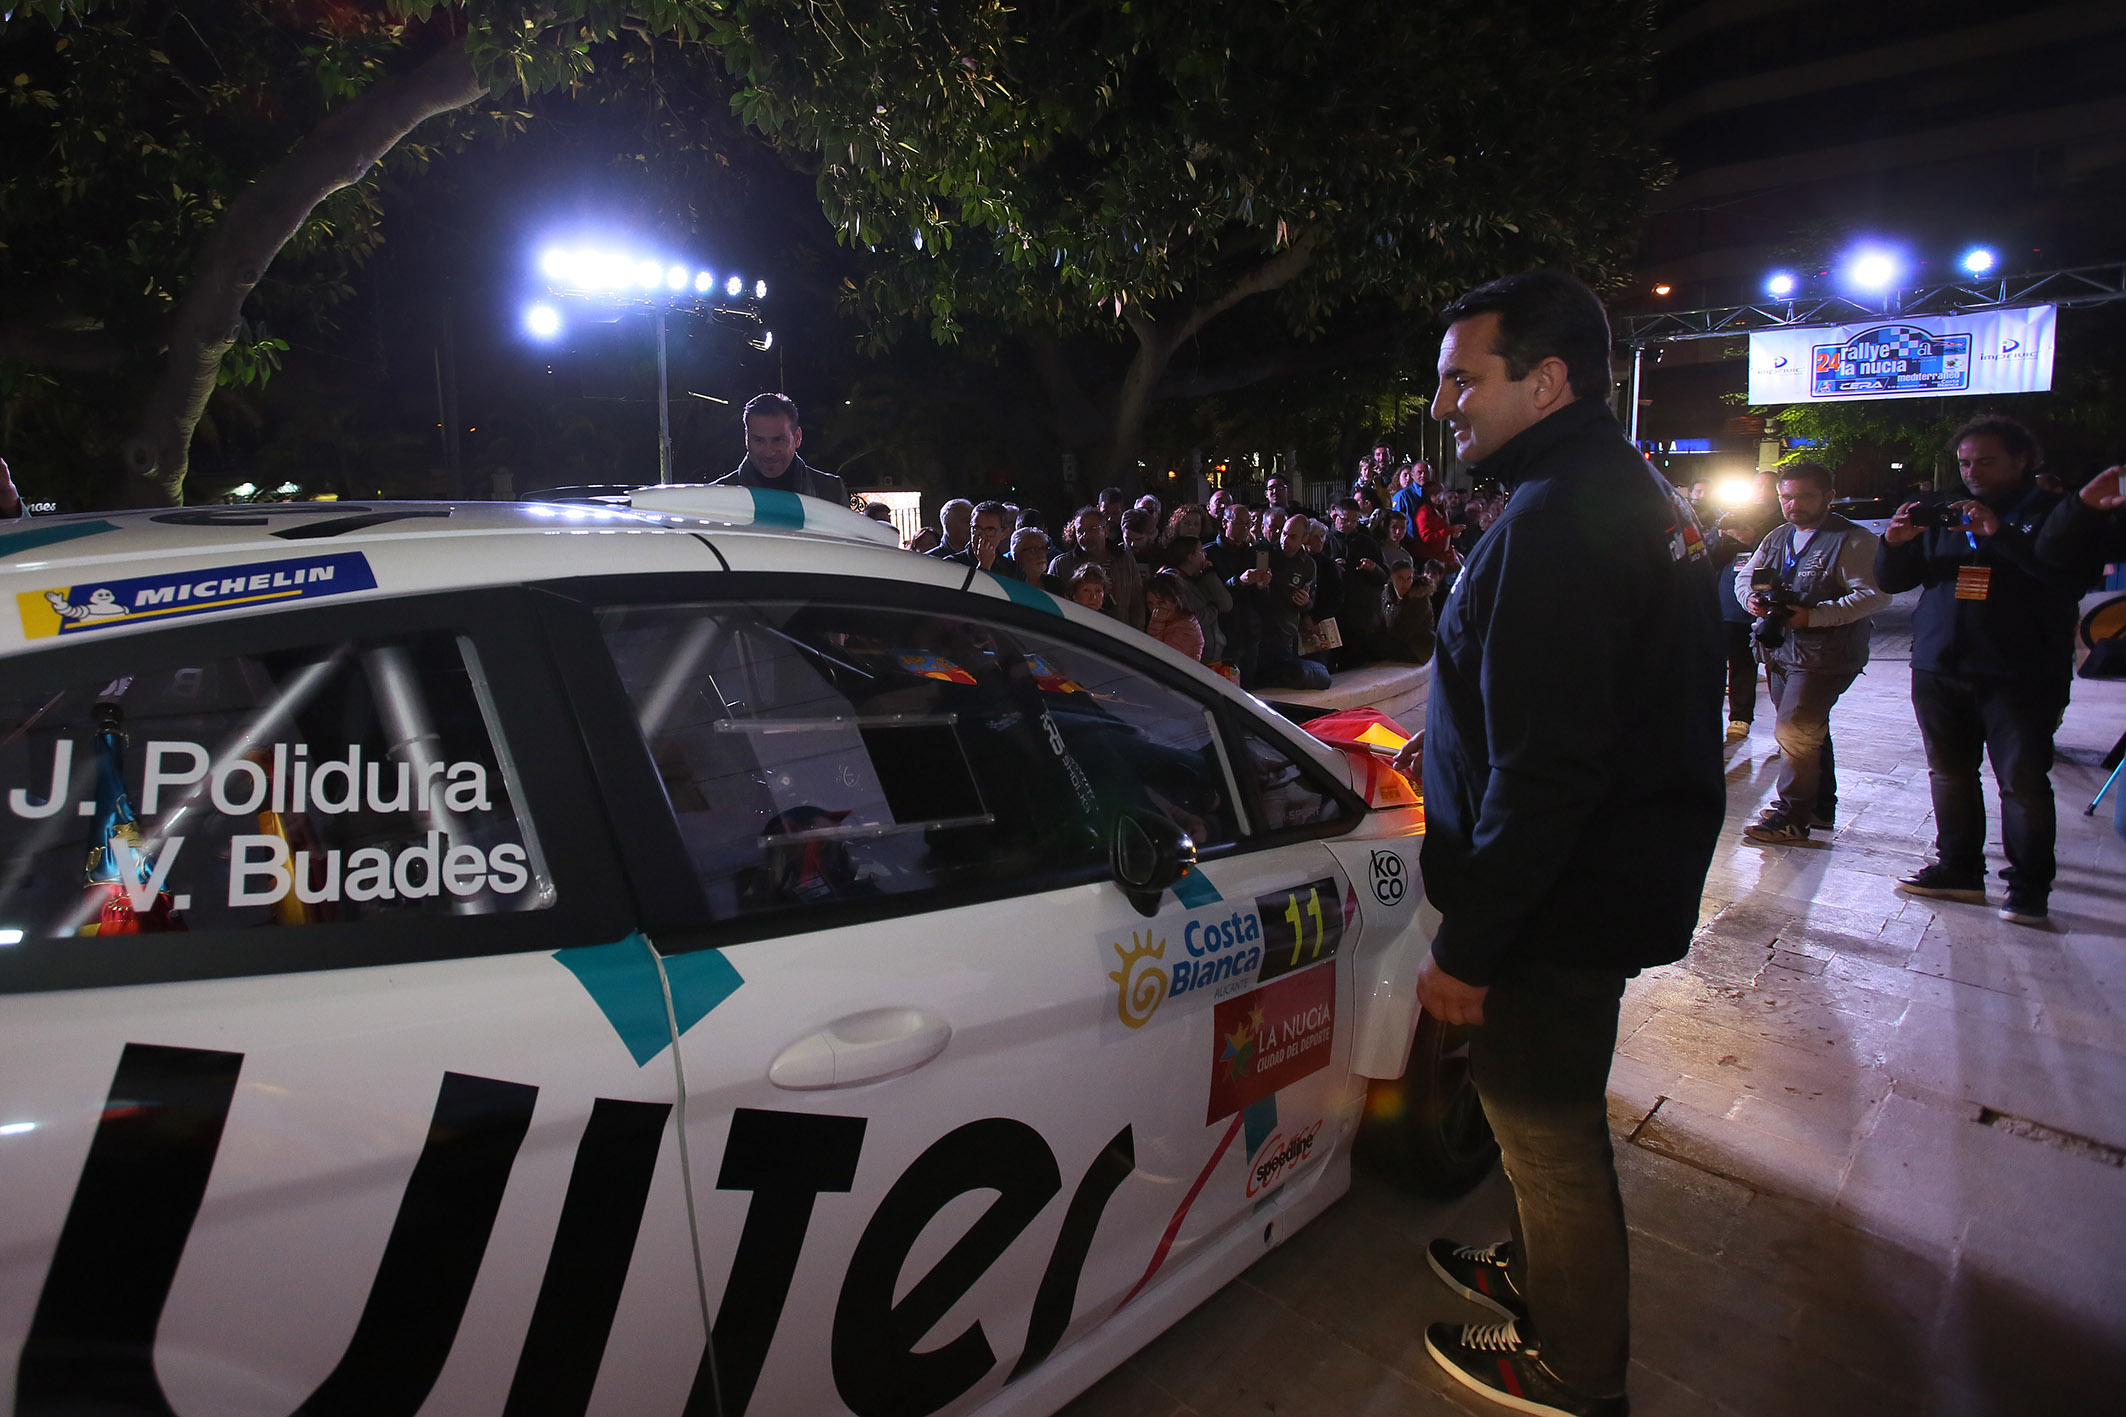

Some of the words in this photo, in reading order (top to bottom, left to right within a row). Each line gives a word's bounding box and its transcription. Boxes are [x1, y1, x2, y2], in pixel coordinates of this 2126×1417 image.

[1816, 352, 1842, 373] 24
[1840, 341, 1890, 362] rallye
[1840, 361, 1855, 376] la
[135, 564, 335, 608] MICHELIN
[9, 739, 95, 818] J.
[141, 738, 490, 816] Polidura
[109, 836, 191, 913] V.
[228, 830, 528, 908] Buades
[1183, 911, 1260, 959] Costa
[1284, 887, 1324, 967] 11
[1168, 945, 1262, 998] Blanca
[1213, 977, 1250, 1000] ALICANTE
[1256, 1049, 1286, 1074] CIUDAD
[1286, 1043, 1301, 1062] DEL
[1300, 1028, 1331, 1057] DEPORTE
[1257, 1028, 1279, 1055] LA
[1256, 1133, 1314, 1182] speedline
